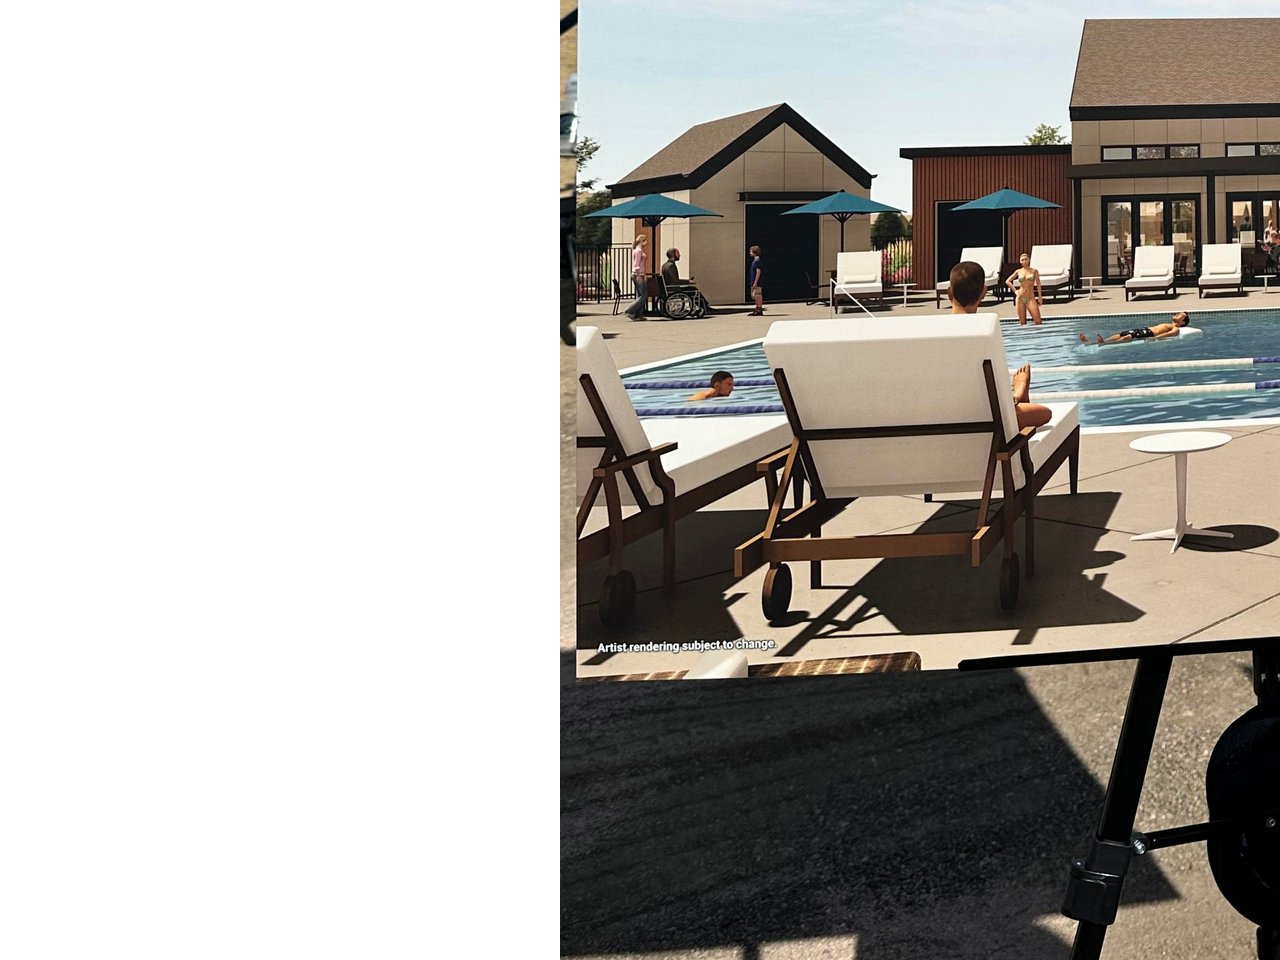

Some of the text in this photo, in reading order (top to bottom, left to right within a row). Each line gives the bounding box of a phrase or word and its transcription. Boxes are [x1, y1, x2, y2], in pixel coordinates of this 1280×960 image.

[597, 639, 778, 653] Artist rendering subject to change.
